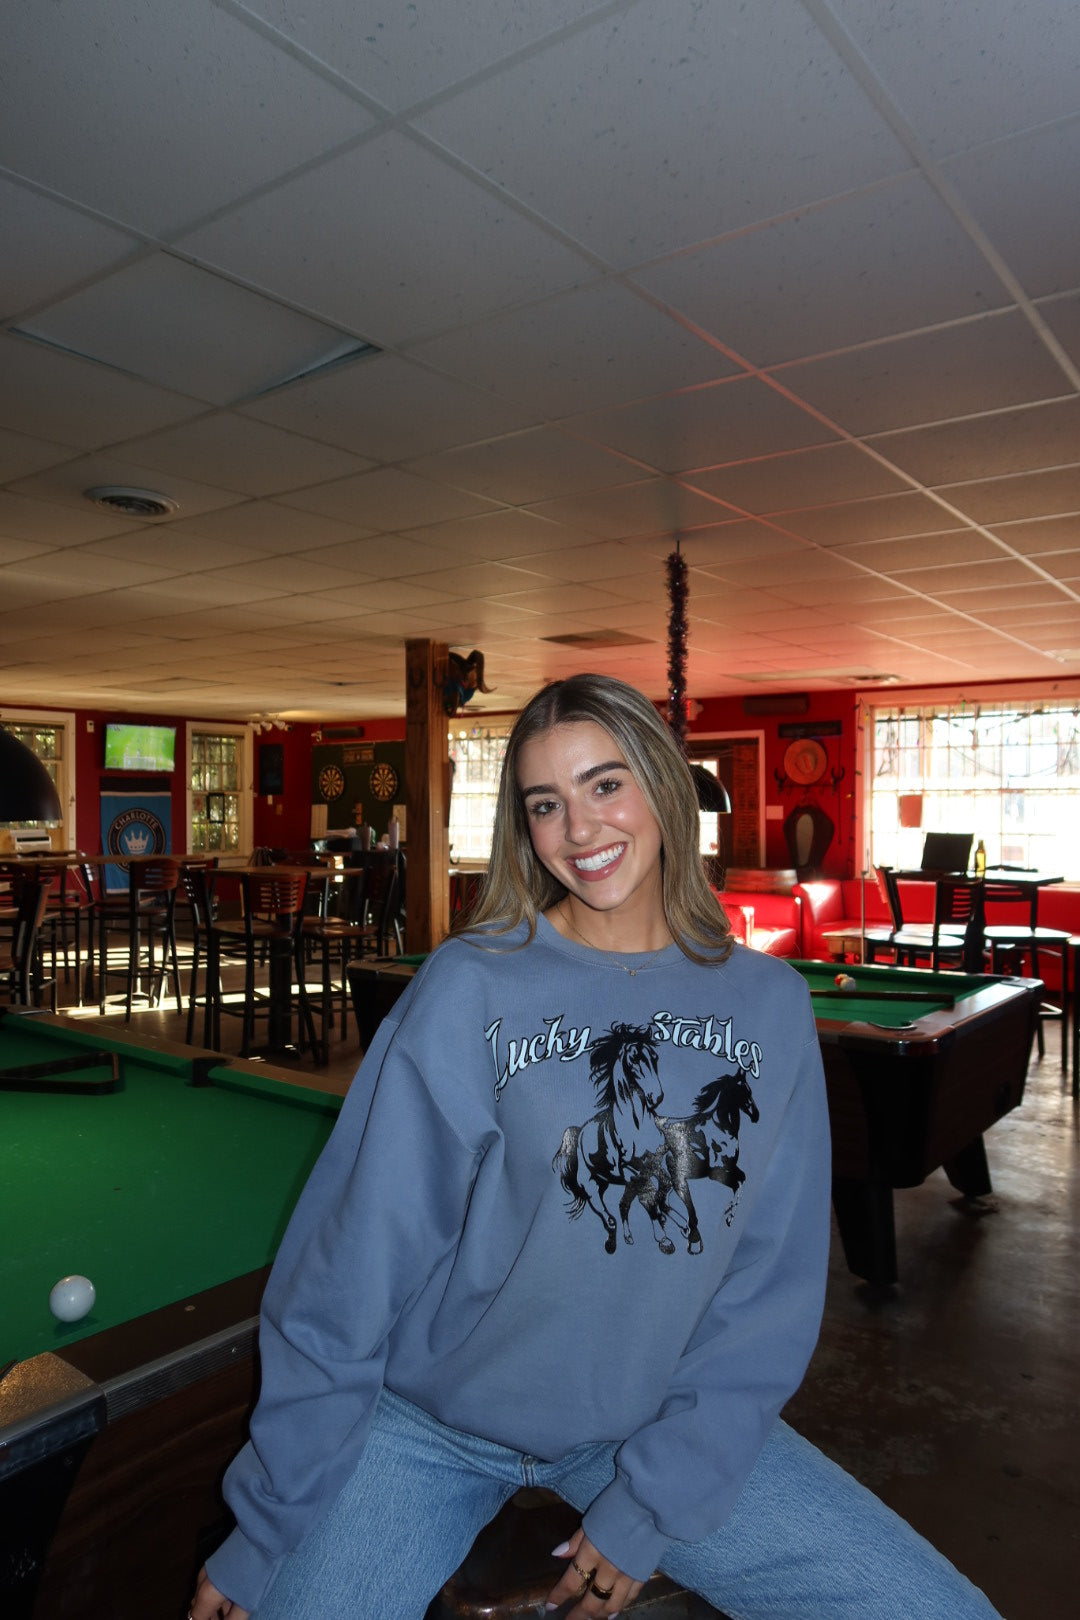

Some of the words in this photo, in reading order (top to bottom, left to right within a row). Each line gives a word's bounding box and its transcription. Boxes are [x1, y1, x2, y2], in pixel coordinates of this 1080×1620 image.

[114, 811, 159, 830] CHARLOTTE
[484, 1013, 594, 1103] Lucky
[652, 1010, 763, 1079] Stables
